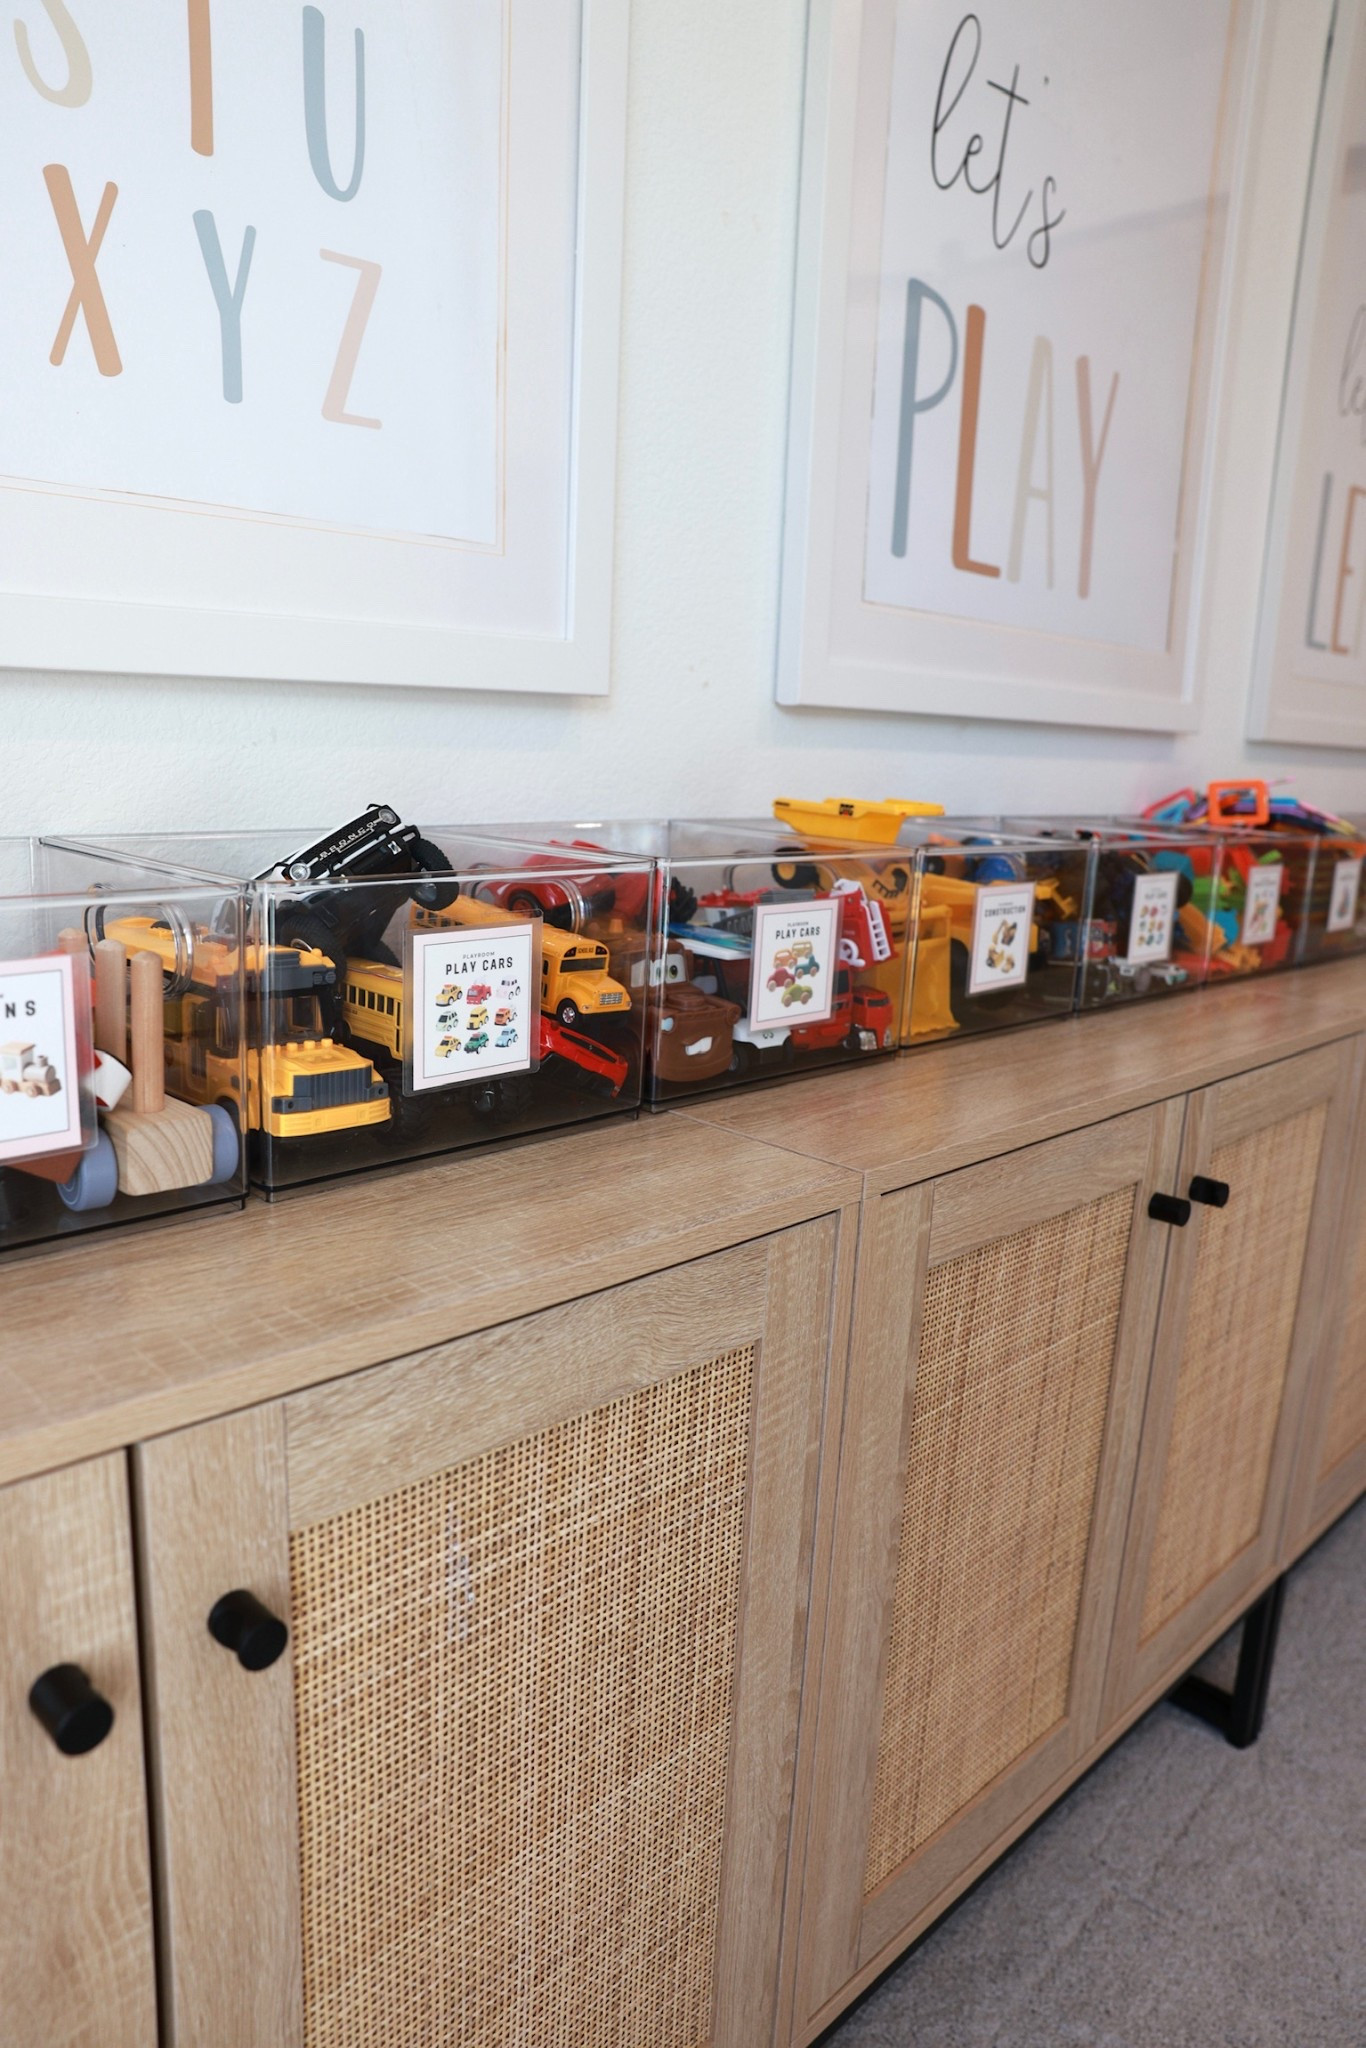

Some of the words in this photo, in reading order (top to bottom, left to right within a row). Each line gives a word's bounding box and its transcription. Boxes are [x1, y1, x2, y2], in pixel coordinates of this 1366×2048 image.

[302, 5, 366, 202] U
[930, 13, 1066, 269] let's
[42, 163, 123, 378] X
[192, 209, 257, 404] Y
[319, 247, 382, 430] Z
[891, 277, 1120, 600] PLAY
[319, 821, 378, 861] BRONCO
[984, 905, 1026, 918] CONSTRUCTION
[775, 928, 797, 940] PLAY
[800, 926, 821, 938] CARS
[445, 960, 476, 976] PLAY
[482, 956, 513, 972] CARS
[462, 951, 495, 960] PLAYROOM
